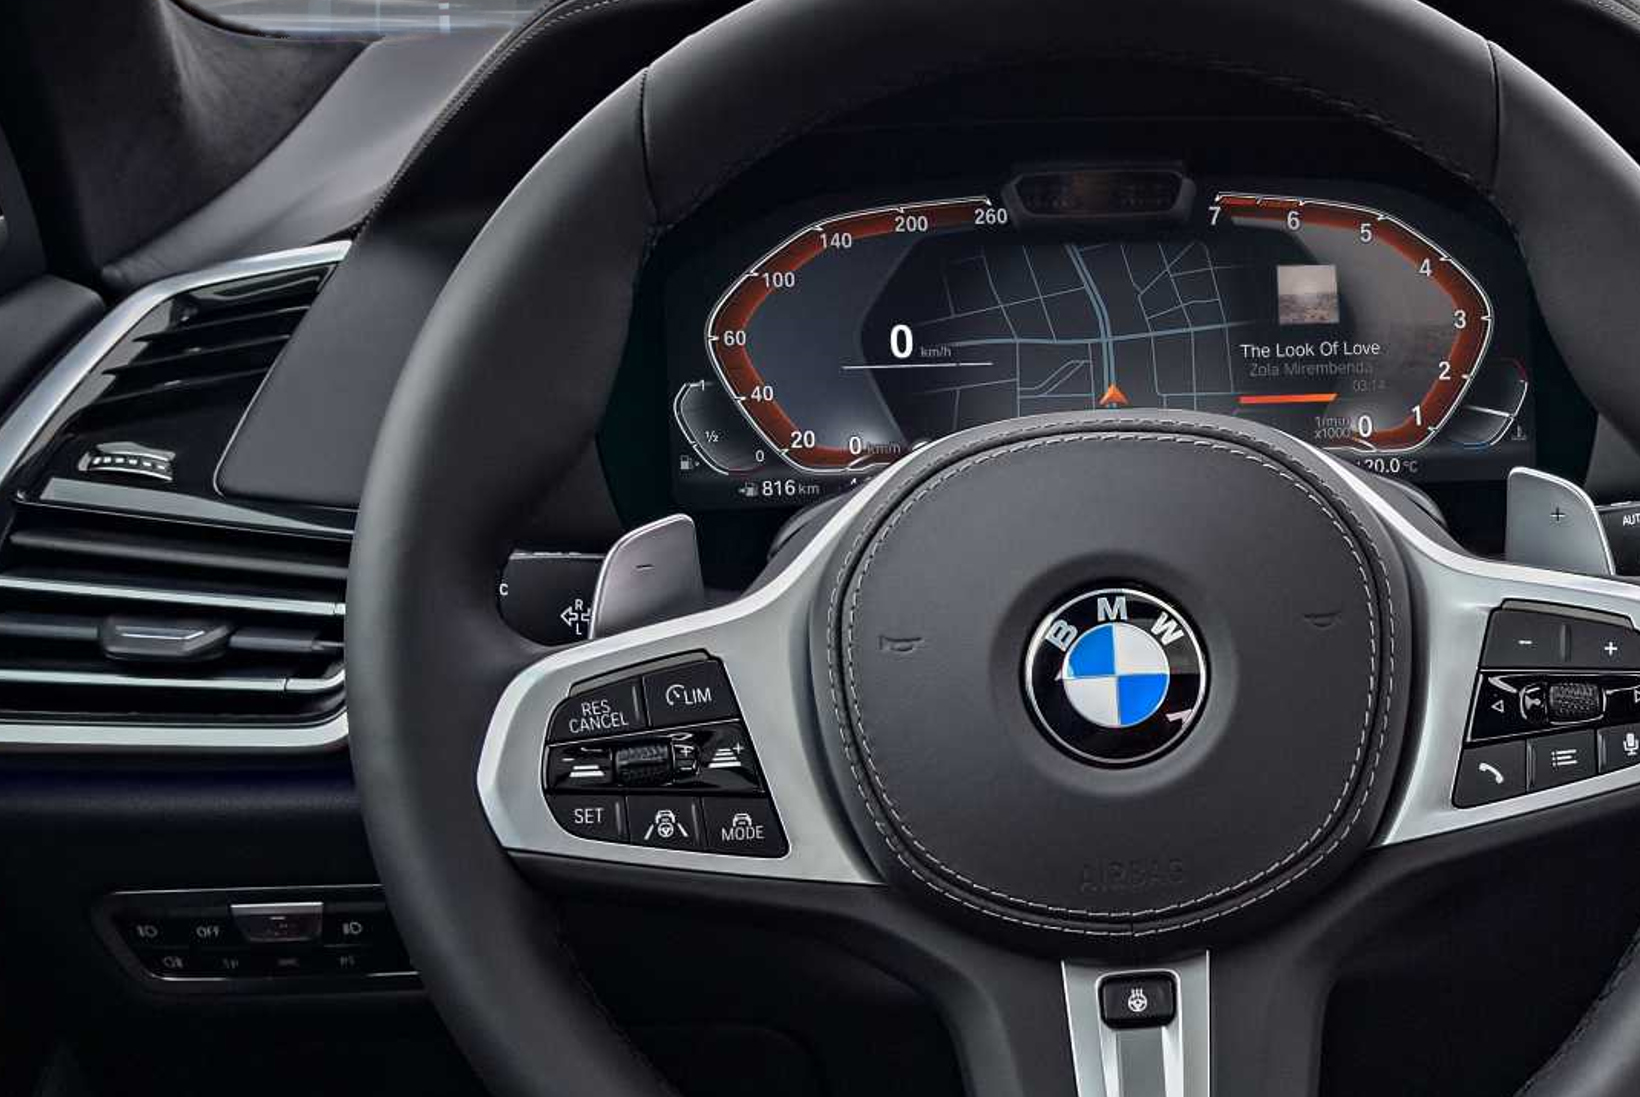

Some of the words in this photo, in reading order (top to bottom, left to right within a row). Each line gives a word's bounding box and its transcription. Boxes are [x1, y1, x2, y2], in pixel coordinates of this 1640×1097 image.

[894, 215, 928, 232] 200
[974, 208, 1008, 225] 260
[1208, 206, 1222, 225] 7
[1286, 211, 1301, 231] 6
[820, 233, 853, 249] 140
[1359, 224, 1373, 243] 5
[1419, 259, 1433, 277] 4
[763, 272, 796, 288] 100
[1453, 310, 1467, 329] 3
[723, 330, 746, 346] 60
[889, 324, 914, 359] 0
[920, 345, 952, 357] km/h
[1240, 344, 1271, 358] The
[1275, 343, 1315, 357] Look
[1320, 341, 1339, 356] Of
[1344, 341, 1381, 355] Love
[1249, 363, 1280, 377] Zola
[1438, 361, 1451, 380] 2
[750, 385, 774, 402] 40
[1411, 406, 1422, 426] 1
[1357, 415, 1373, 437] 0
[790, 431, 816, 449] 20
[848, 436, 862, 455] 0
[755, 449, 766, 462] 0
[762, 479, 796, 496] 816
[799, 484, 820, 495] km
[574, 598, 584, 611] R
[575, 622, 583, 635] L
[1045, 595, 1185, 652] BMW
[684, 687, 712, 704] LIM
[581, 699, 611, 716] RES
[568, 713, 629, 734] CANCEL
[573, 807, 604, 825] SET
[721, 824, 765, 842] MODE
